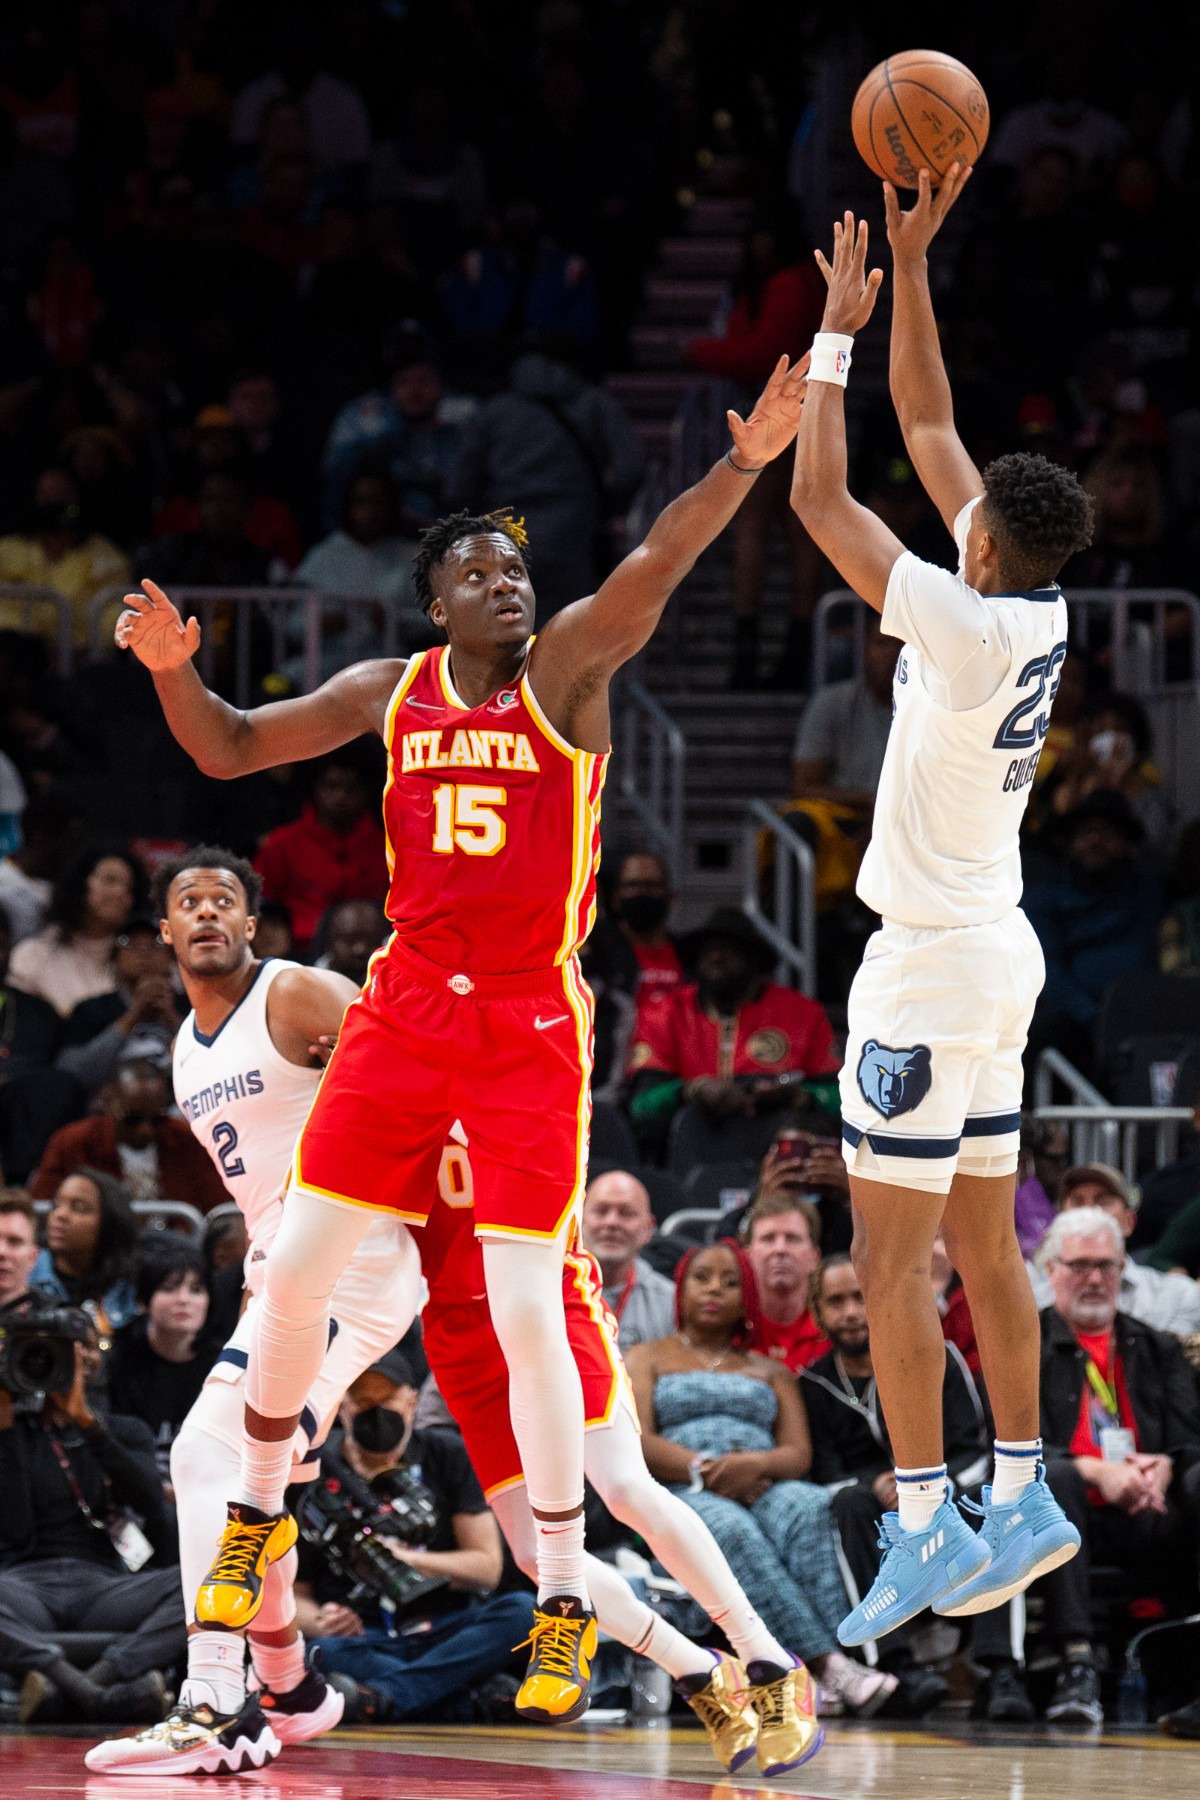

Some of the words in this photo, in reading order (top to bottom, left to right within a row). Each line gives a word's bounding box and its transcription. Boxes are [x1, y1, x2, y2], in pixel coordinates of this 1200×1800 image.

[402, 729, 540, 774] ATLANTA
[432, 783, 507, 857] 15
[212, 1121, 246, 1178] 2
